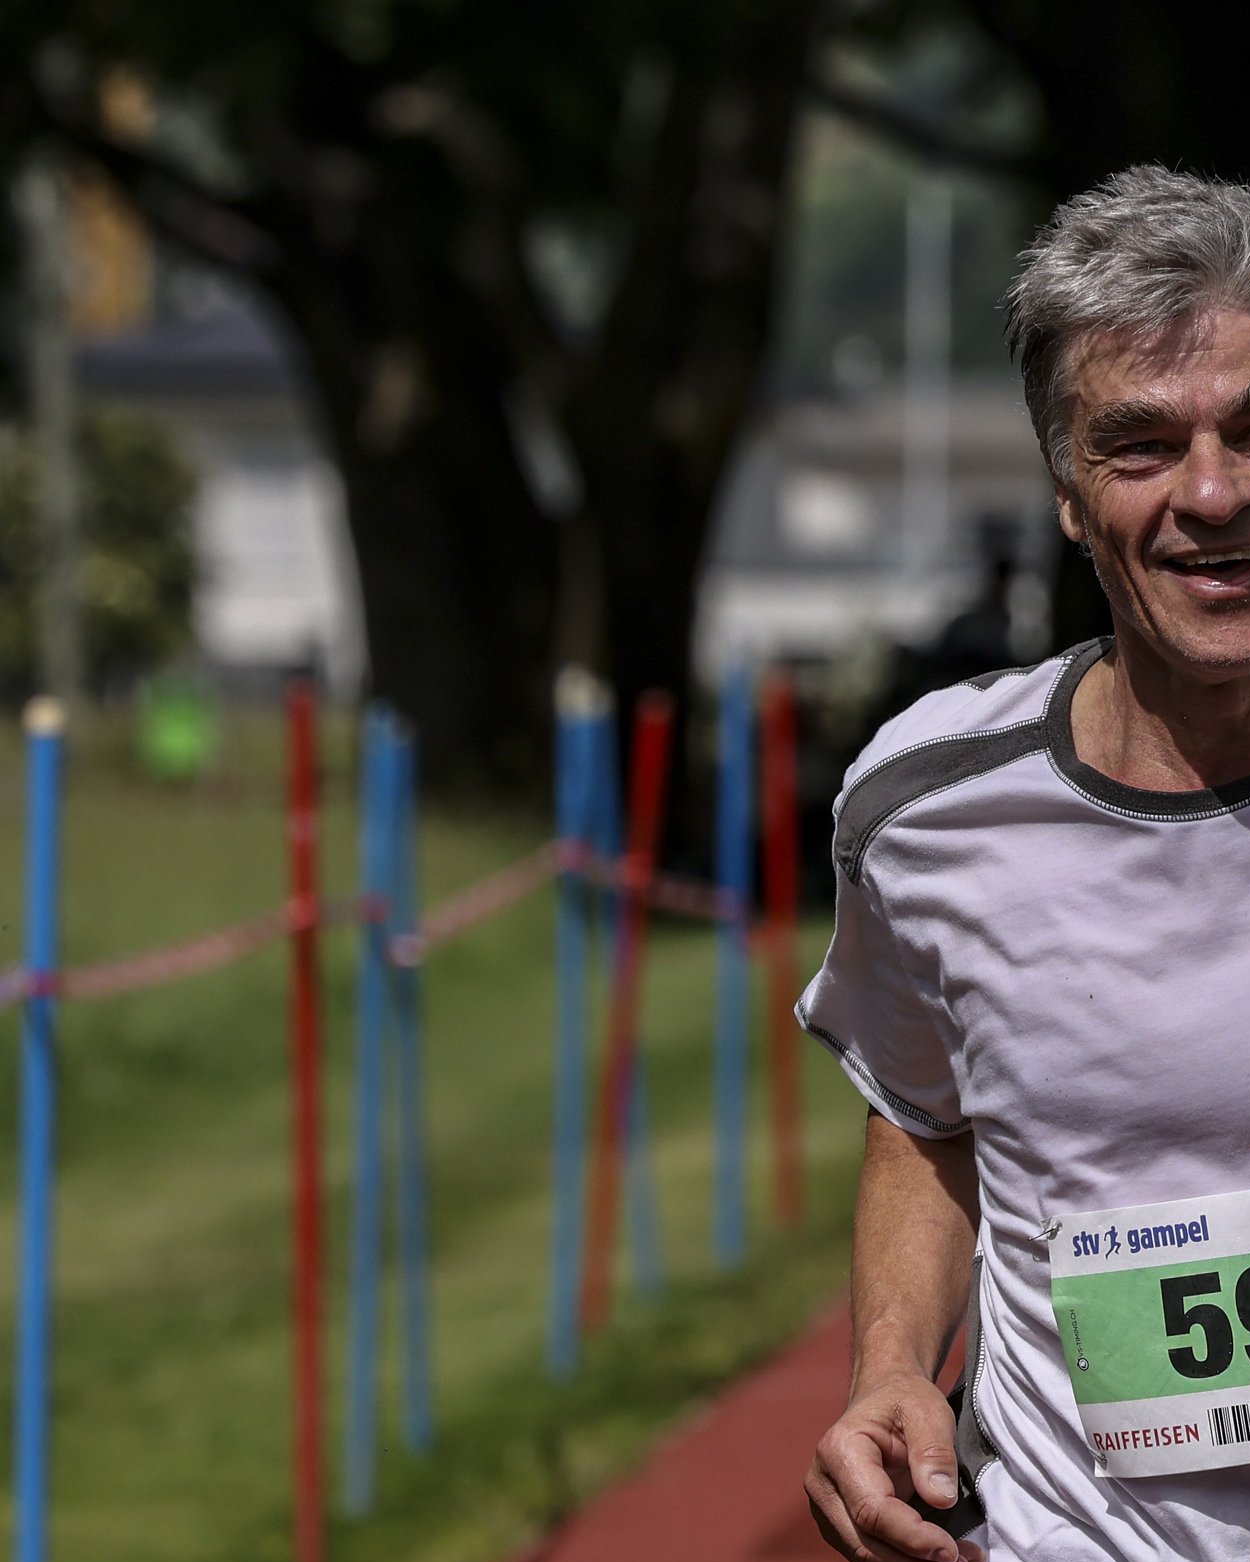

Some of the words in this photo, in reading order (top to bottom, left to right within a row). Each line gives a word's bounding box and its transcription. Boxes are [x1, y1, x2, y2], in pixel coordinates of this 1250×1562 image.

[1072, 1230, 1100, 1257] stv
[1127, 1214, 1210, 1254] gampel
[1093, 1423, 1200, 1451] RAIFFEISEN
